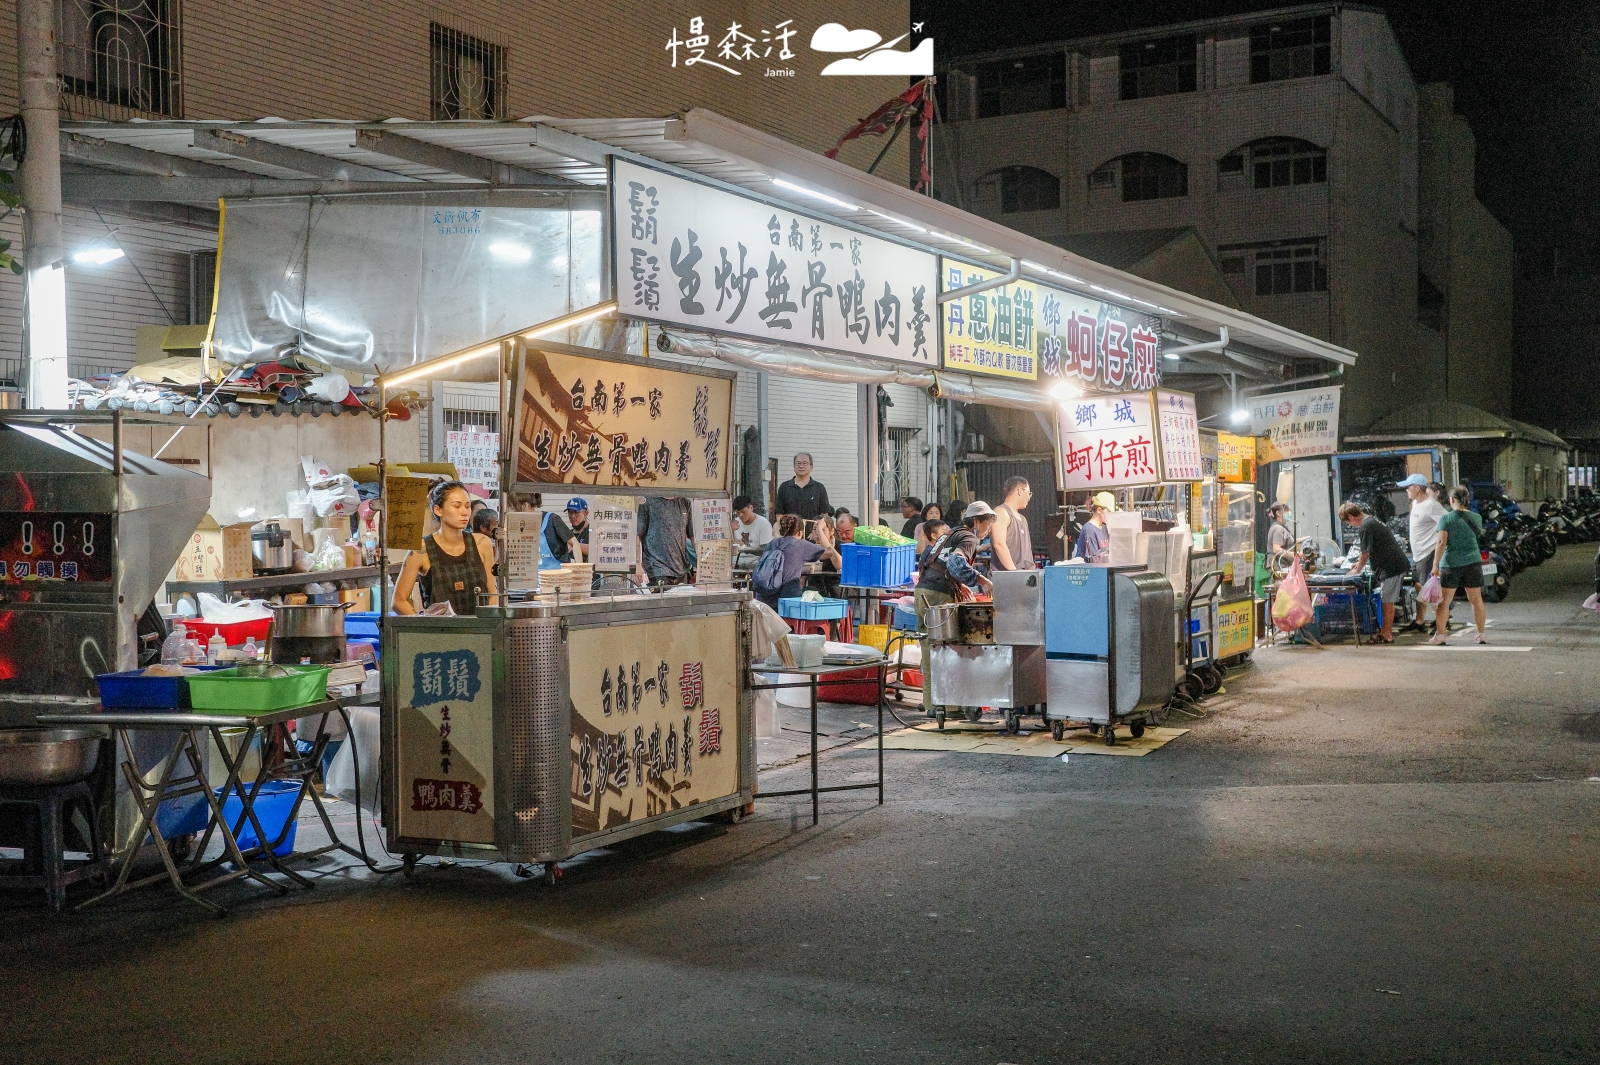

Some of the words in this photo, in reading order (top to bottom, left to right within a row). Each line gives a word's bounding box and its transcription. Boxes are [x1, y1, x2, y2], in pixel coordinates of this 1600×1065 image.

[628, 180, 661, 312] 鬍鬚
[767, 213, 863, 267] 台南第一家
[670, 228, 931, 360] 生炒無骨鴨肉羹
[947, 267, 964, 337] 丹丹
[1042, 292, 1063, 380] 鄉城
[1066, 309, 1159, 389] 蚵仔煎
[570, 378, 662, 418] 台南第一家
[1075, 399, 1136, 427] 鄉城
[534, 428, 691, 481] 生炒無骨鴨肉羹
[1066, 435, 1154, 481] 蚵仔煎
[594, 510, 633, 520] 內用寫單
[420, 657, 470, 698] 鬍鬚
[601, 658, 669, 716] 台南第一家
[679, 660, 722, 754] 鬍鬚
[579, 714, 693, 797] 生炒無骨鴨肉羹
[418, 782, 477, 812] 鴨肉羹
